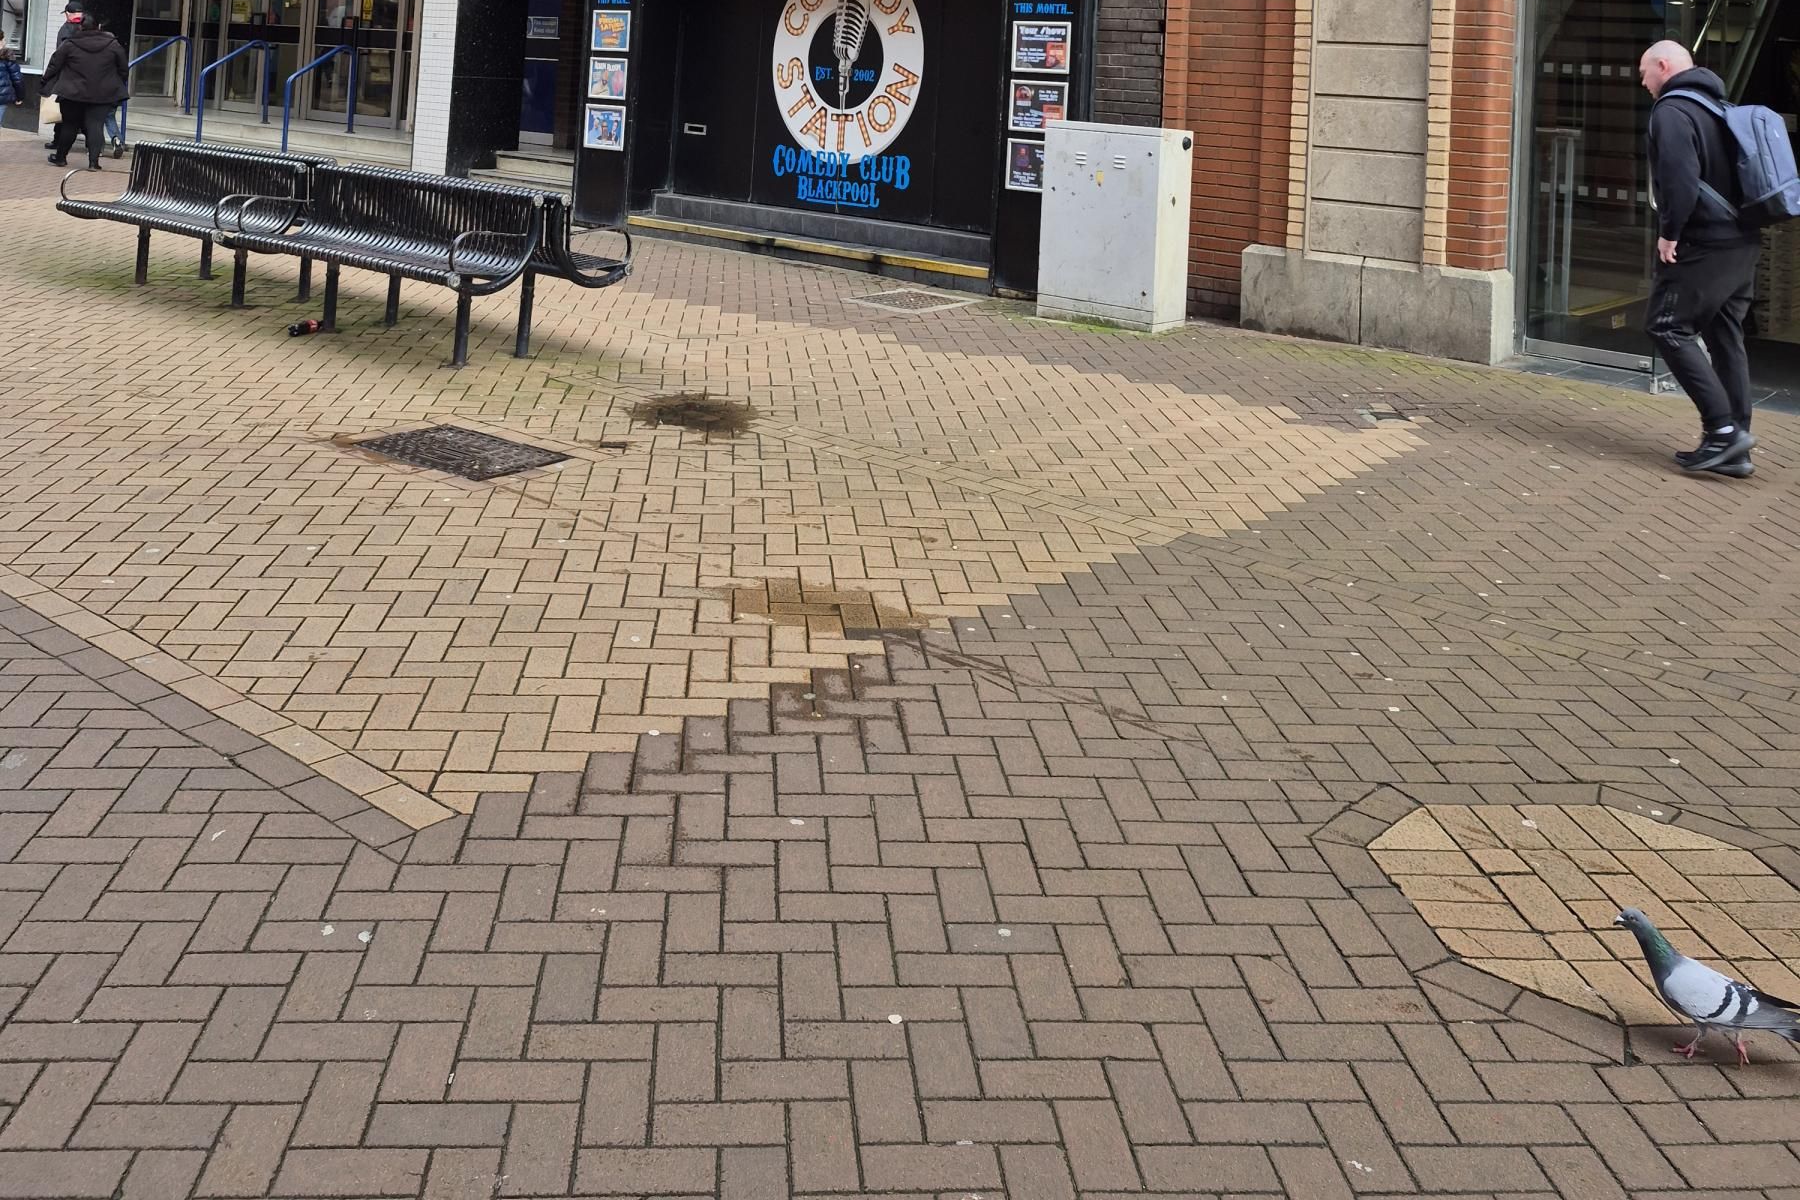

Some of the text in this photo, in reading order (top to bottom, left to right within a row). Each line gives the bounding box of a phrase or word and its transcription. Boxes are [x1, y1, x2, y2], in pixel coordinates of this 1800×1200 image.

[1014, 2, 1033, 14] THIS
[853, 69, 875, 82] 2002
[777, 57, 919, 152] STATION
[773, 144, 911, 190] COMEDY CLUB
[797, 175, 880, 208] BLACKPOOL
